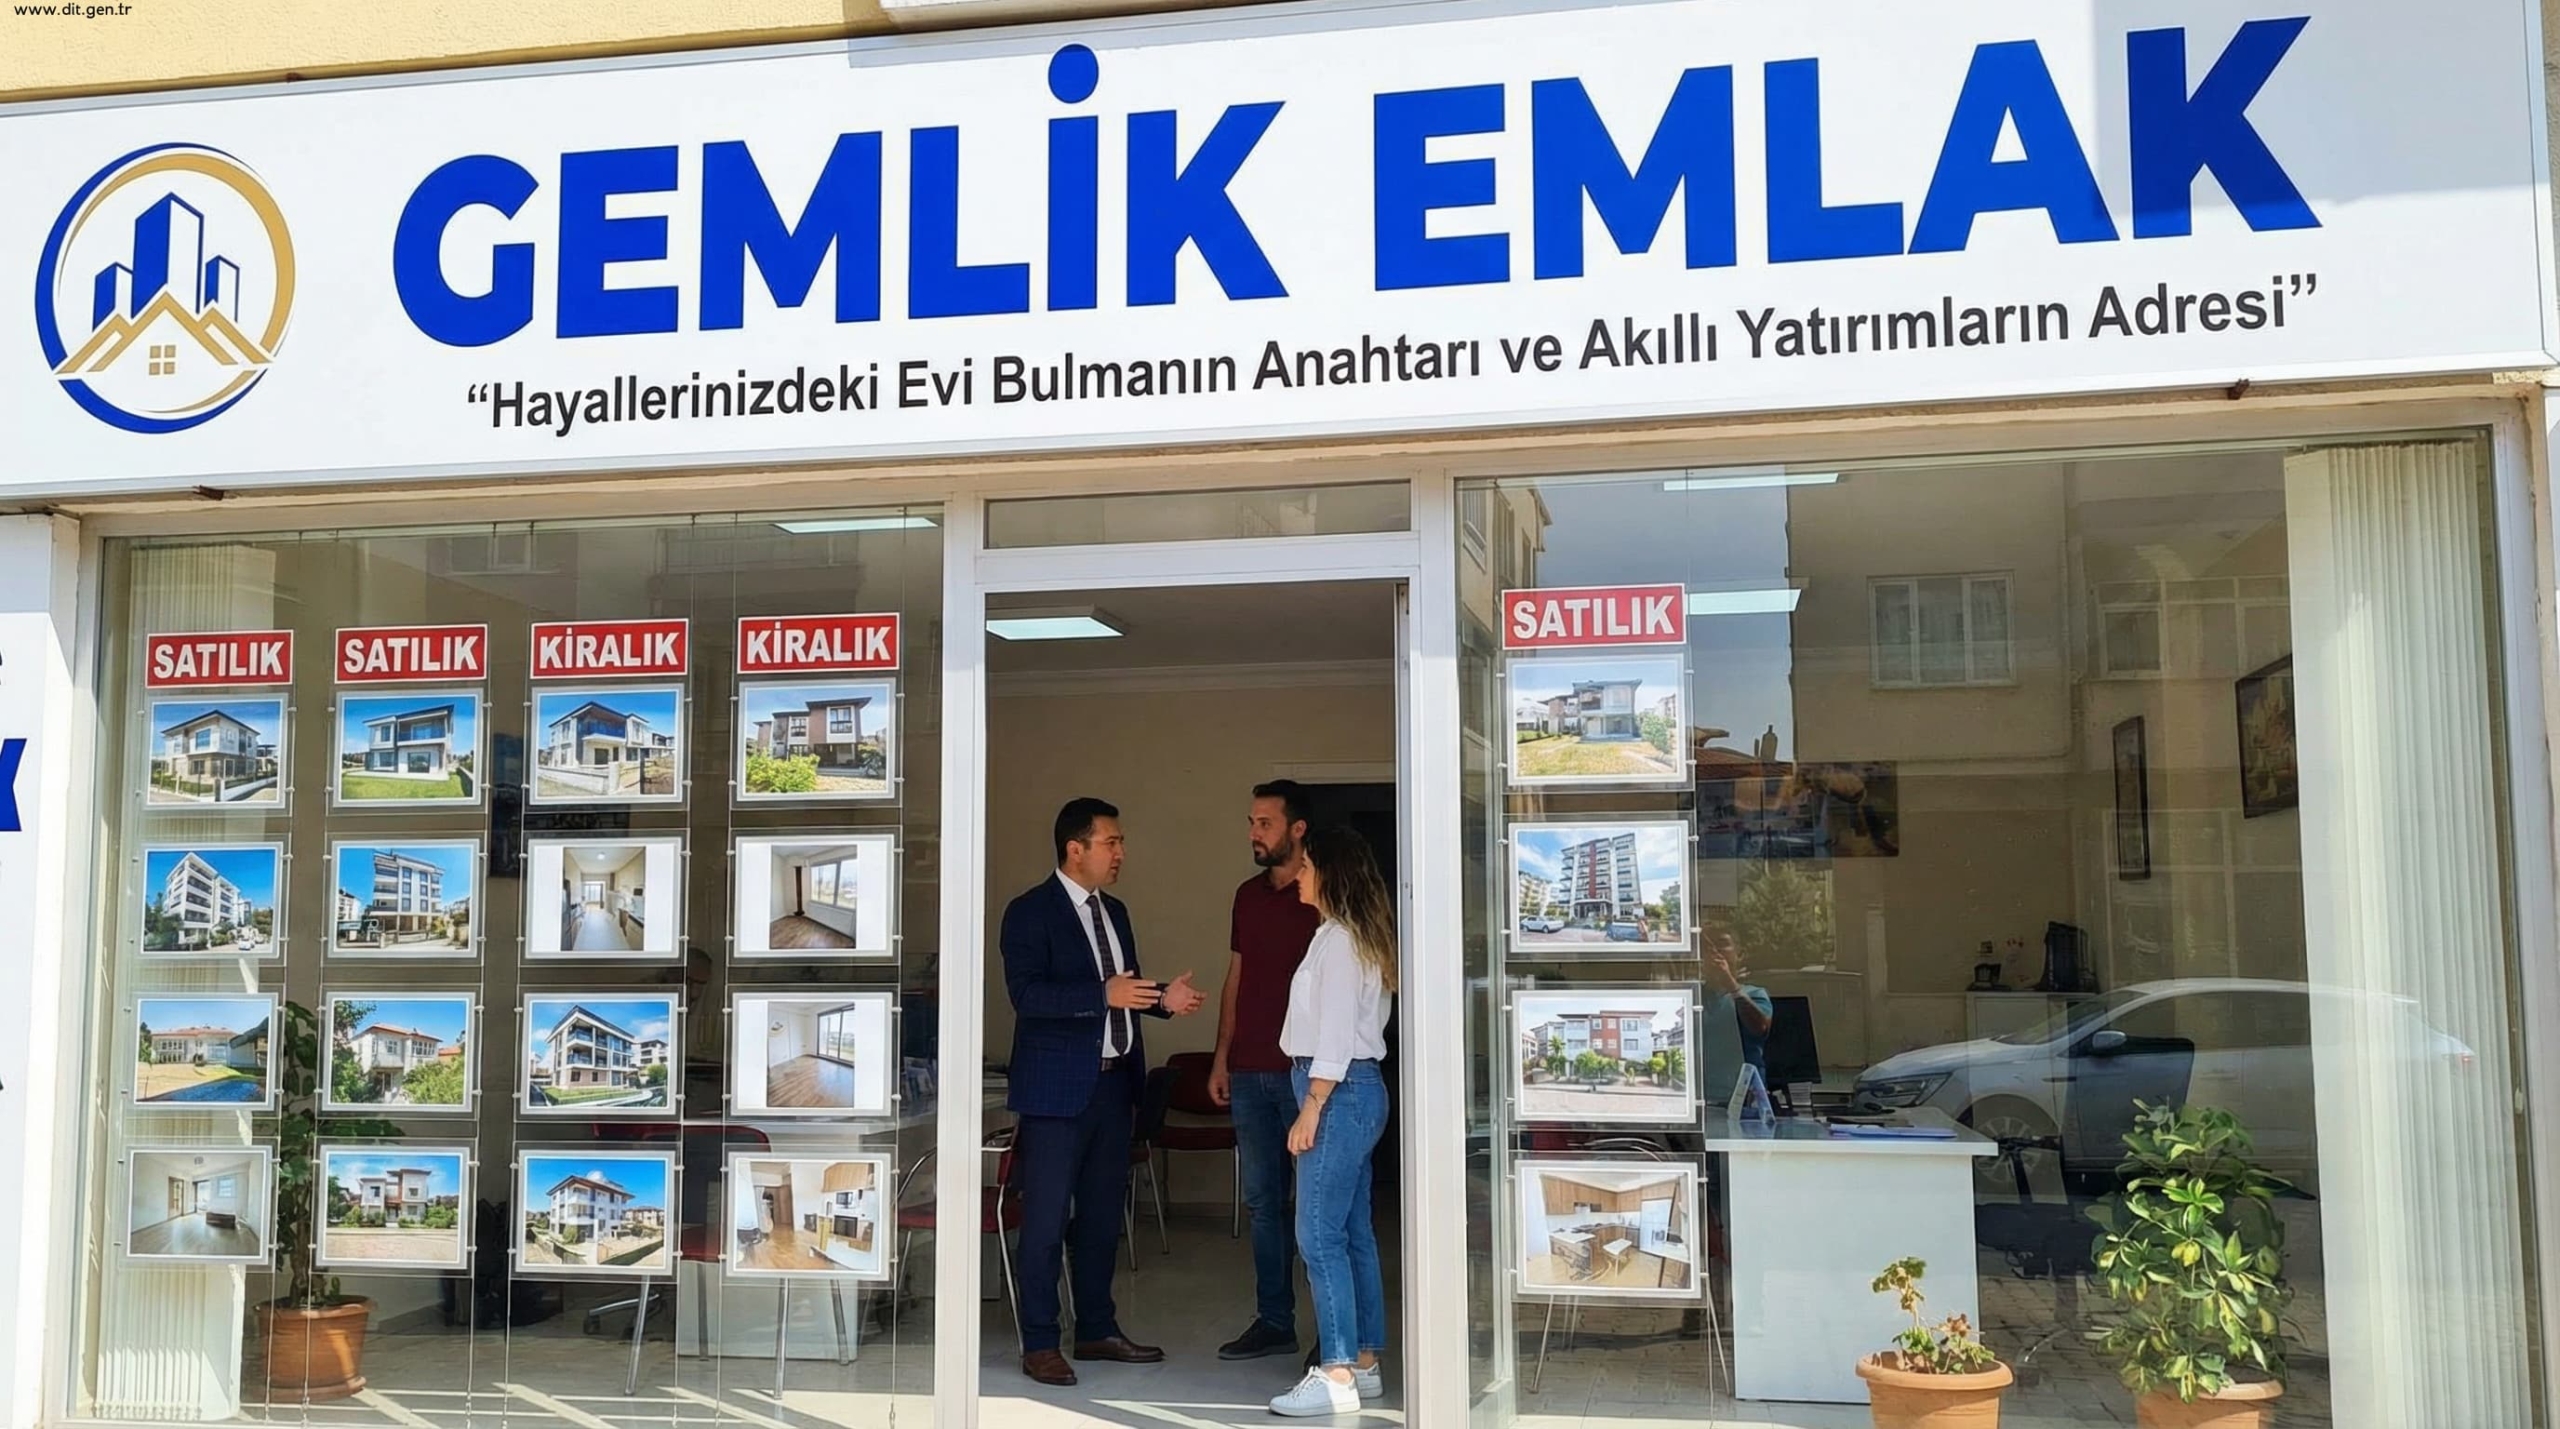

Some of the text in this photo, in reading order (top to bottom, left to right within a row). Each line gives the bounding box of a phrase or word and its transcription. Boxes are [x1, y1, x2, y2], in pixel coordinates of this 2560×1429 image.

[393, 15, 2323, 347] GEMLİK EMLAK
[468, 273, 2317, 438] “Hayallerinizdeki Evi Bulmanın Anahtarı ve Akıllı Yatırımların Adresi”
[1512, 595, 1676, 639] SATILIK
[153, 641, 285, 679] SATILIK
[343, 635, 480, 674] SATILIK
[538, 627, 680, 669] KİRALIK
[746, 621, 891, 664] KİRALIK
